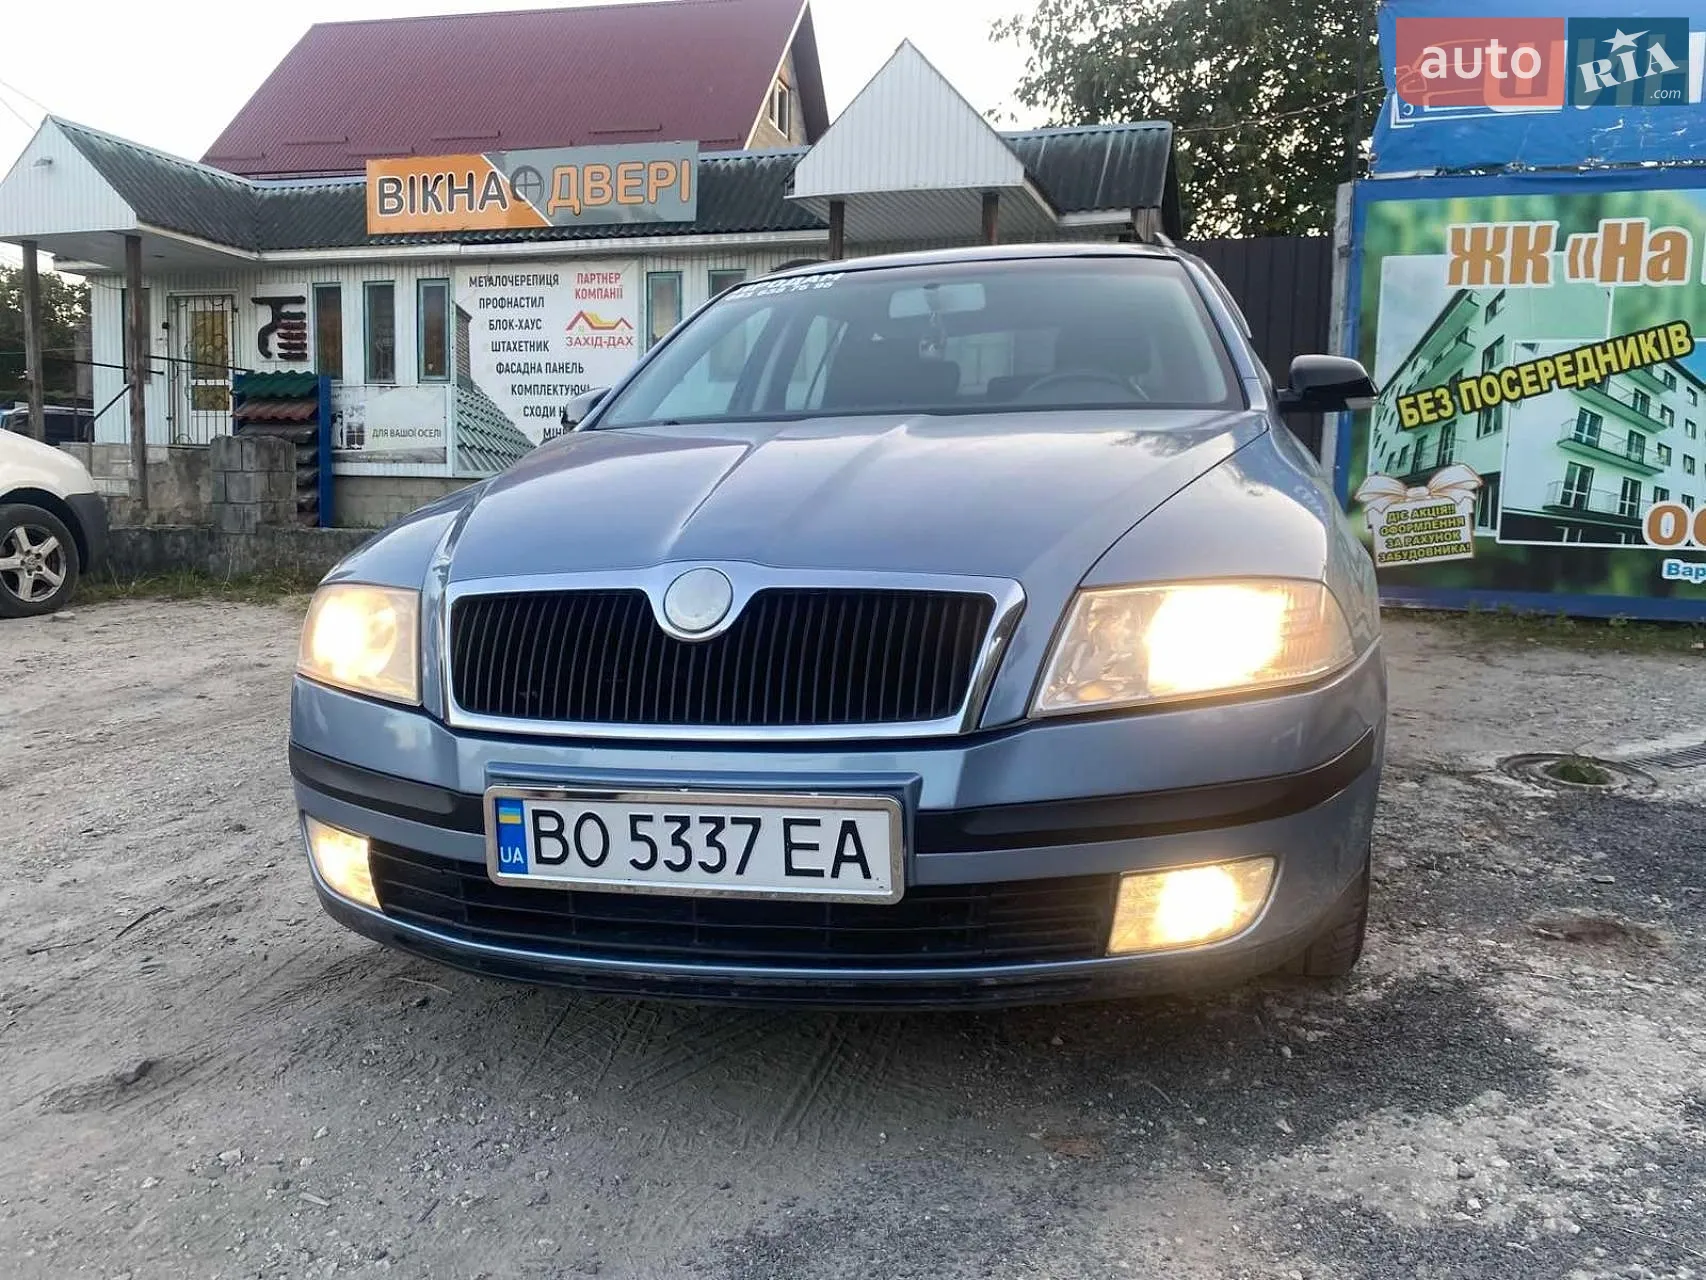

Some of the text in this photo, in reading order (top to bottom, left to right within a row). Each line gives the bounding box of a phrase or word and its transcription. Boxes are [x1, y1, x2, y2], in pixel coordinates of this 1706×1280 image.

[376, 158, 692, 217] ВІКНА ДВЕРІ
[1447, 222, 1557, 287] ЖК
[469, 273, 559, 288] МЕТАЛОЧЕРЕПИЦЯ
[576, 272, 621, 284] ПАРТНЕР
[575, 286, 623, 300] КОМПАНІЇ
[479, 296, 545, 309] ПРОФНАСТИЛ
[488, 318, 542, 331] БЛОК-ХАУС
[491, 340, 550, 353] ШТАХЕТНИК
[566, 336, 634, 348] ЗАХІД-ДАХ
[496, 362, 584, 375] ФАСАДНА ПАНЕЛЬ
[1398, 321, 1694, 429] БЕЗ ПОСЕРЕДНИКІВ
[523, 406, 556, 419] СХОДИ
[372, 428, 441, 438] ДЛЯ ВАШОЇ ОСЕЛІ
[1387, 510, 1409, 524] ДІЄ
[1380, 516, 1466, 537] ОФОРМЛЕННЯ
[1385, 530, 1461, 549] ЗА РАХУНОК
[1379, 543, 1472, 562] ЗАБУДОВНИКА!
[531, 808, 873, 880] BO 5337 EA
[500, 845, 524, 864] UA
